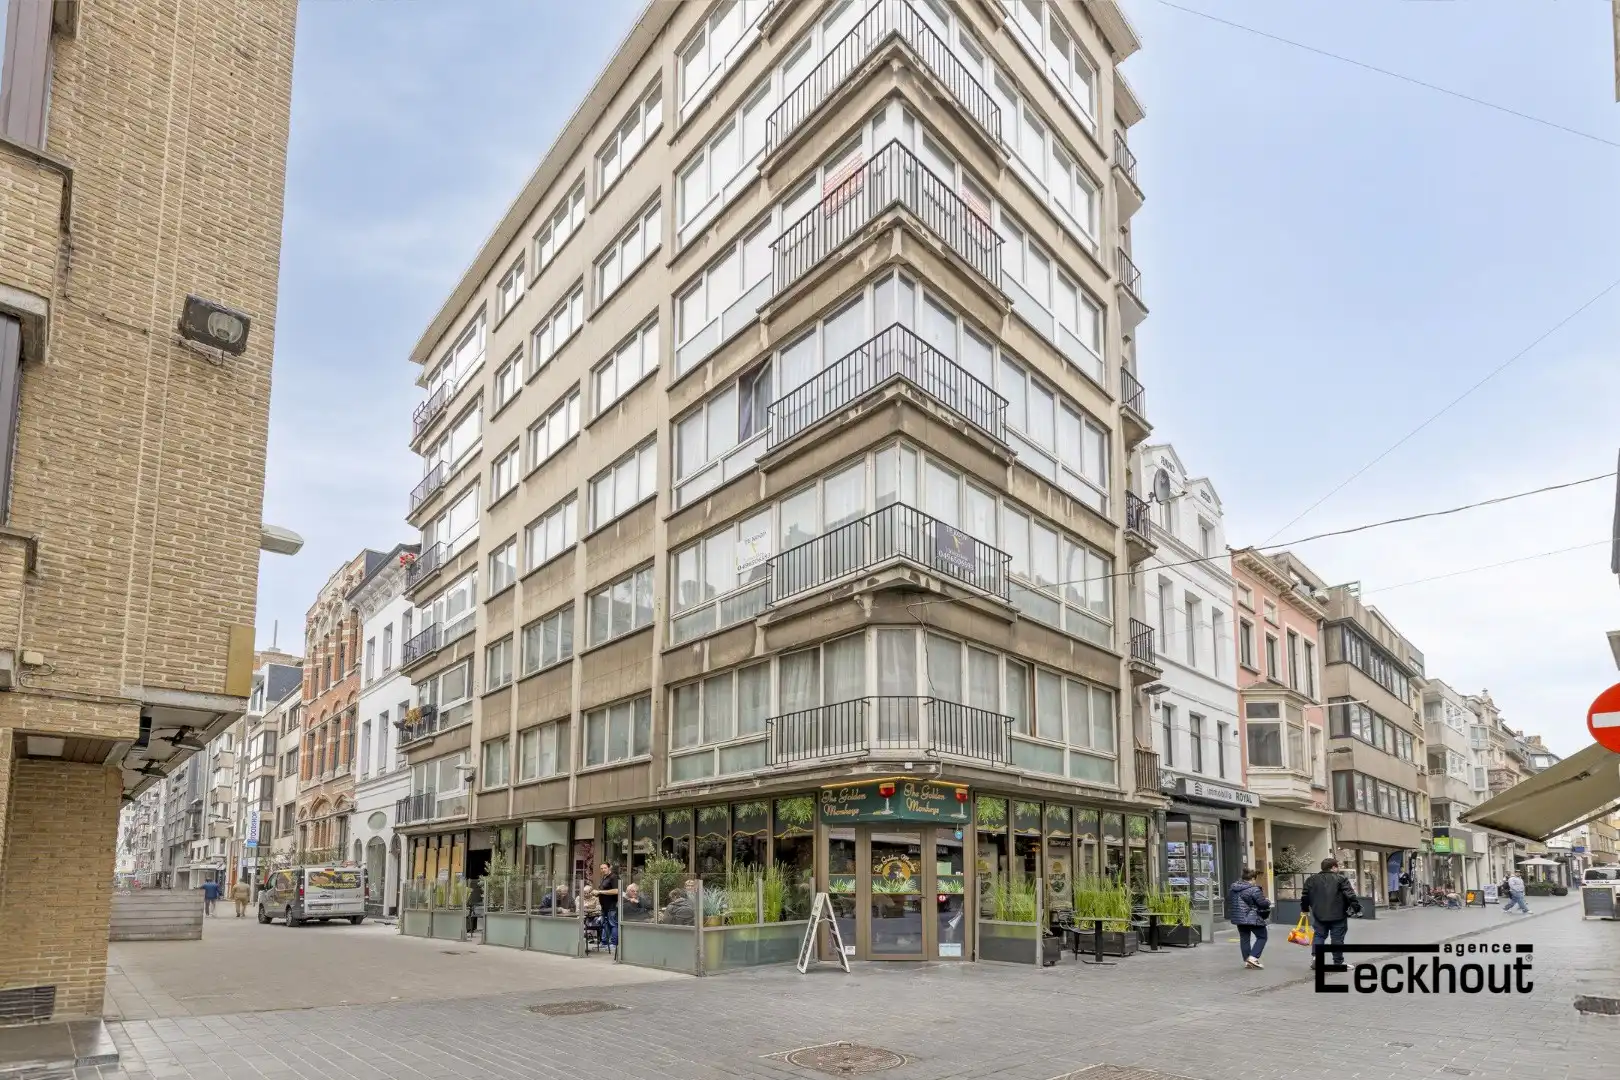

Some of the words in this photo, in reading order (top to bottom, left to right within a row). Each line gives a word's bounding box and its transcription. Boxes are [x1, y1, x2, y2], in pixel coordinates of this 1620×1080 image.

[821, 790, 837, 803] The
[838, 787, 867, 803] Golden
[903, 782, 920, 797] The
[921, 784, 946, 800] Golden
[1235, 792, 1253, 804] ROYAL
